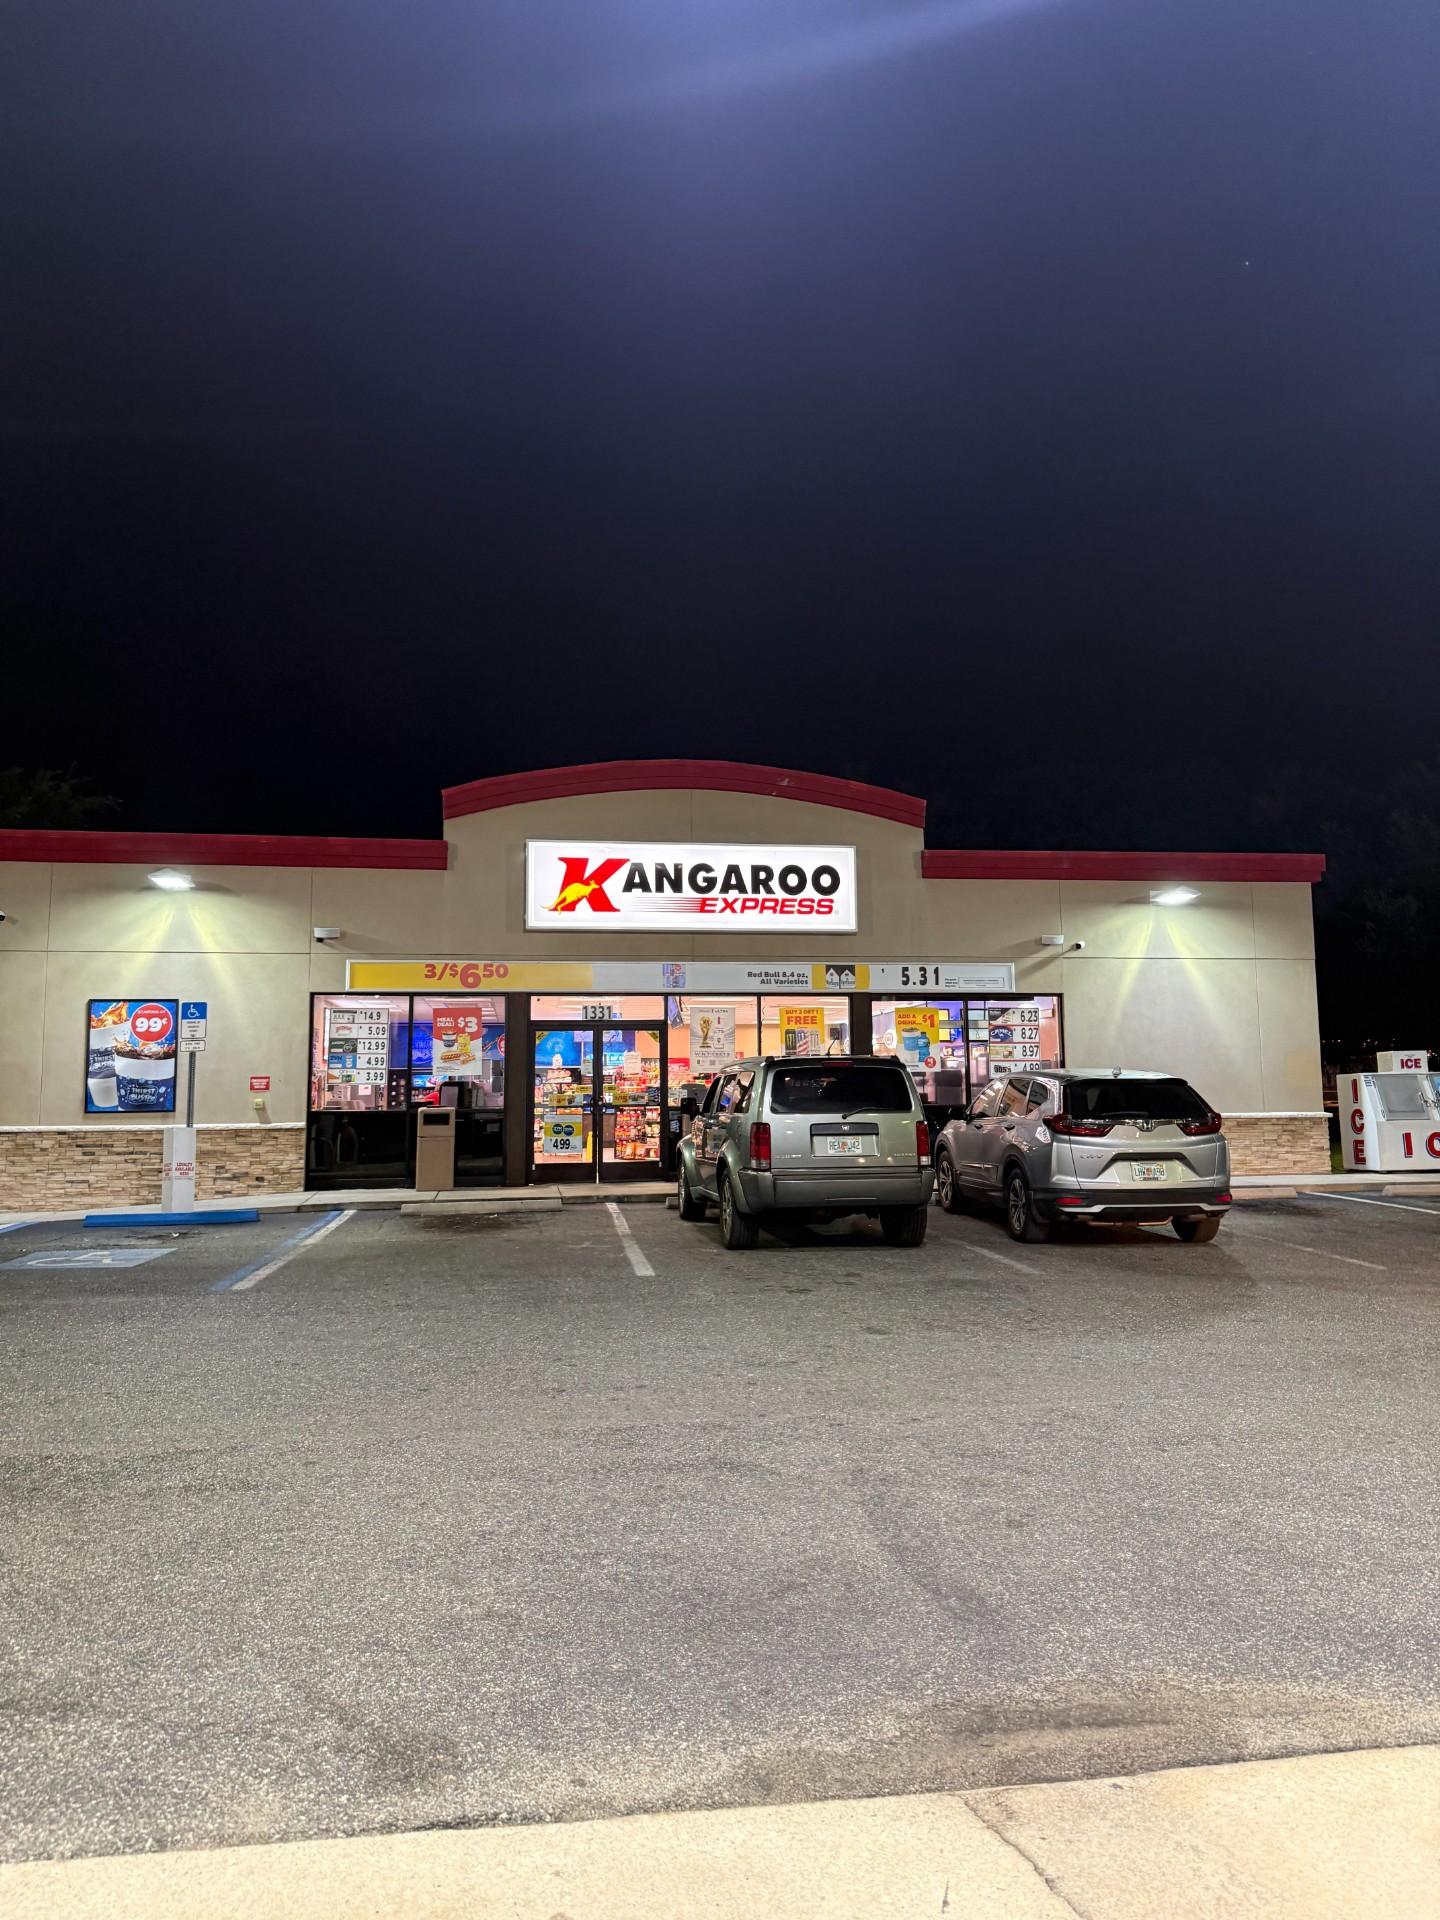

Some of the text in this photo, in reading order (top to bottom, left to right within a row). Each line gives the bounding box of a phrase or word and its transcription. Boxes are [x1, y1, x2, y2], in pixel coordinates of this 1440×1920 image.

[547, 857, 841, 913] KANGAROO
[699, 897, 835, 915] EXPRESS
[774, 977, 809, 985] Varieties
[583, 1005, 611, 1020] 1331
[457, 1016, 478, 1033] $3
[787, 1015, 818, 1025] FREE
[922, 1014, 935, 1028] $1
[1400, 1058, 1422, 1069] ICE
